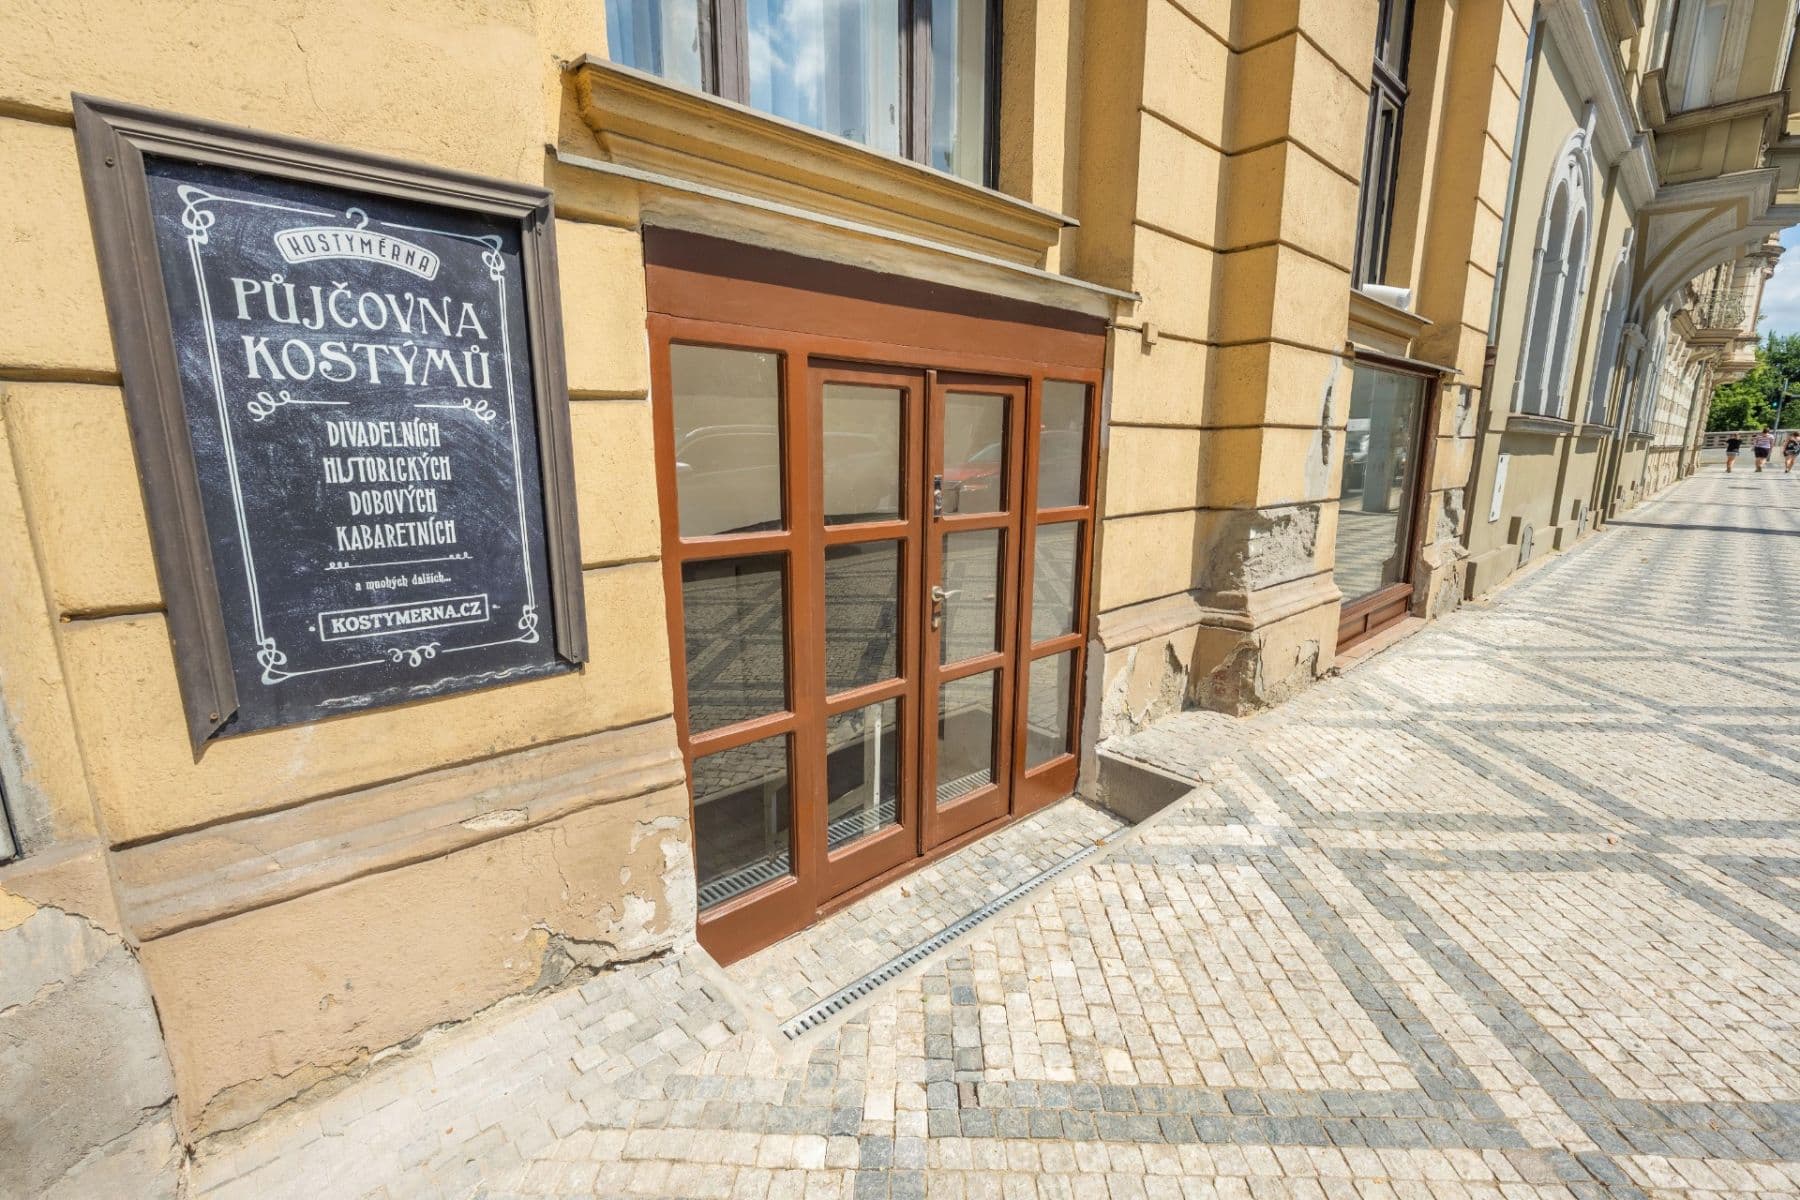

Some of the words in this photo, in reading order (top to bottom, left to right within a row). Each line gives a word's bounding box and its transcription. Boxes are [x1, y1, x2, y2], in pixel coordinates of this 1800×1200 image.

[287, 232, 431, 273] KOSTYMÉRNA
[231, 273, 488, 340] PŮJČOVNA
[242, 335, 493, 389] KOSTÝMŮ
[326, 417, 441, 448] DIVADELNÍCH
[322, 452, 452, 484] HISTORICKÝCH
[348, 485, 438, 516] DOBOVÝCH
[336, 516, 457, 551] KABARETNÍCH
[355, 582, 362, 591] a
[365, 575, 408, 592] mnohých
[330, 601, 482, 635] KOSTYMERNA.CZ
